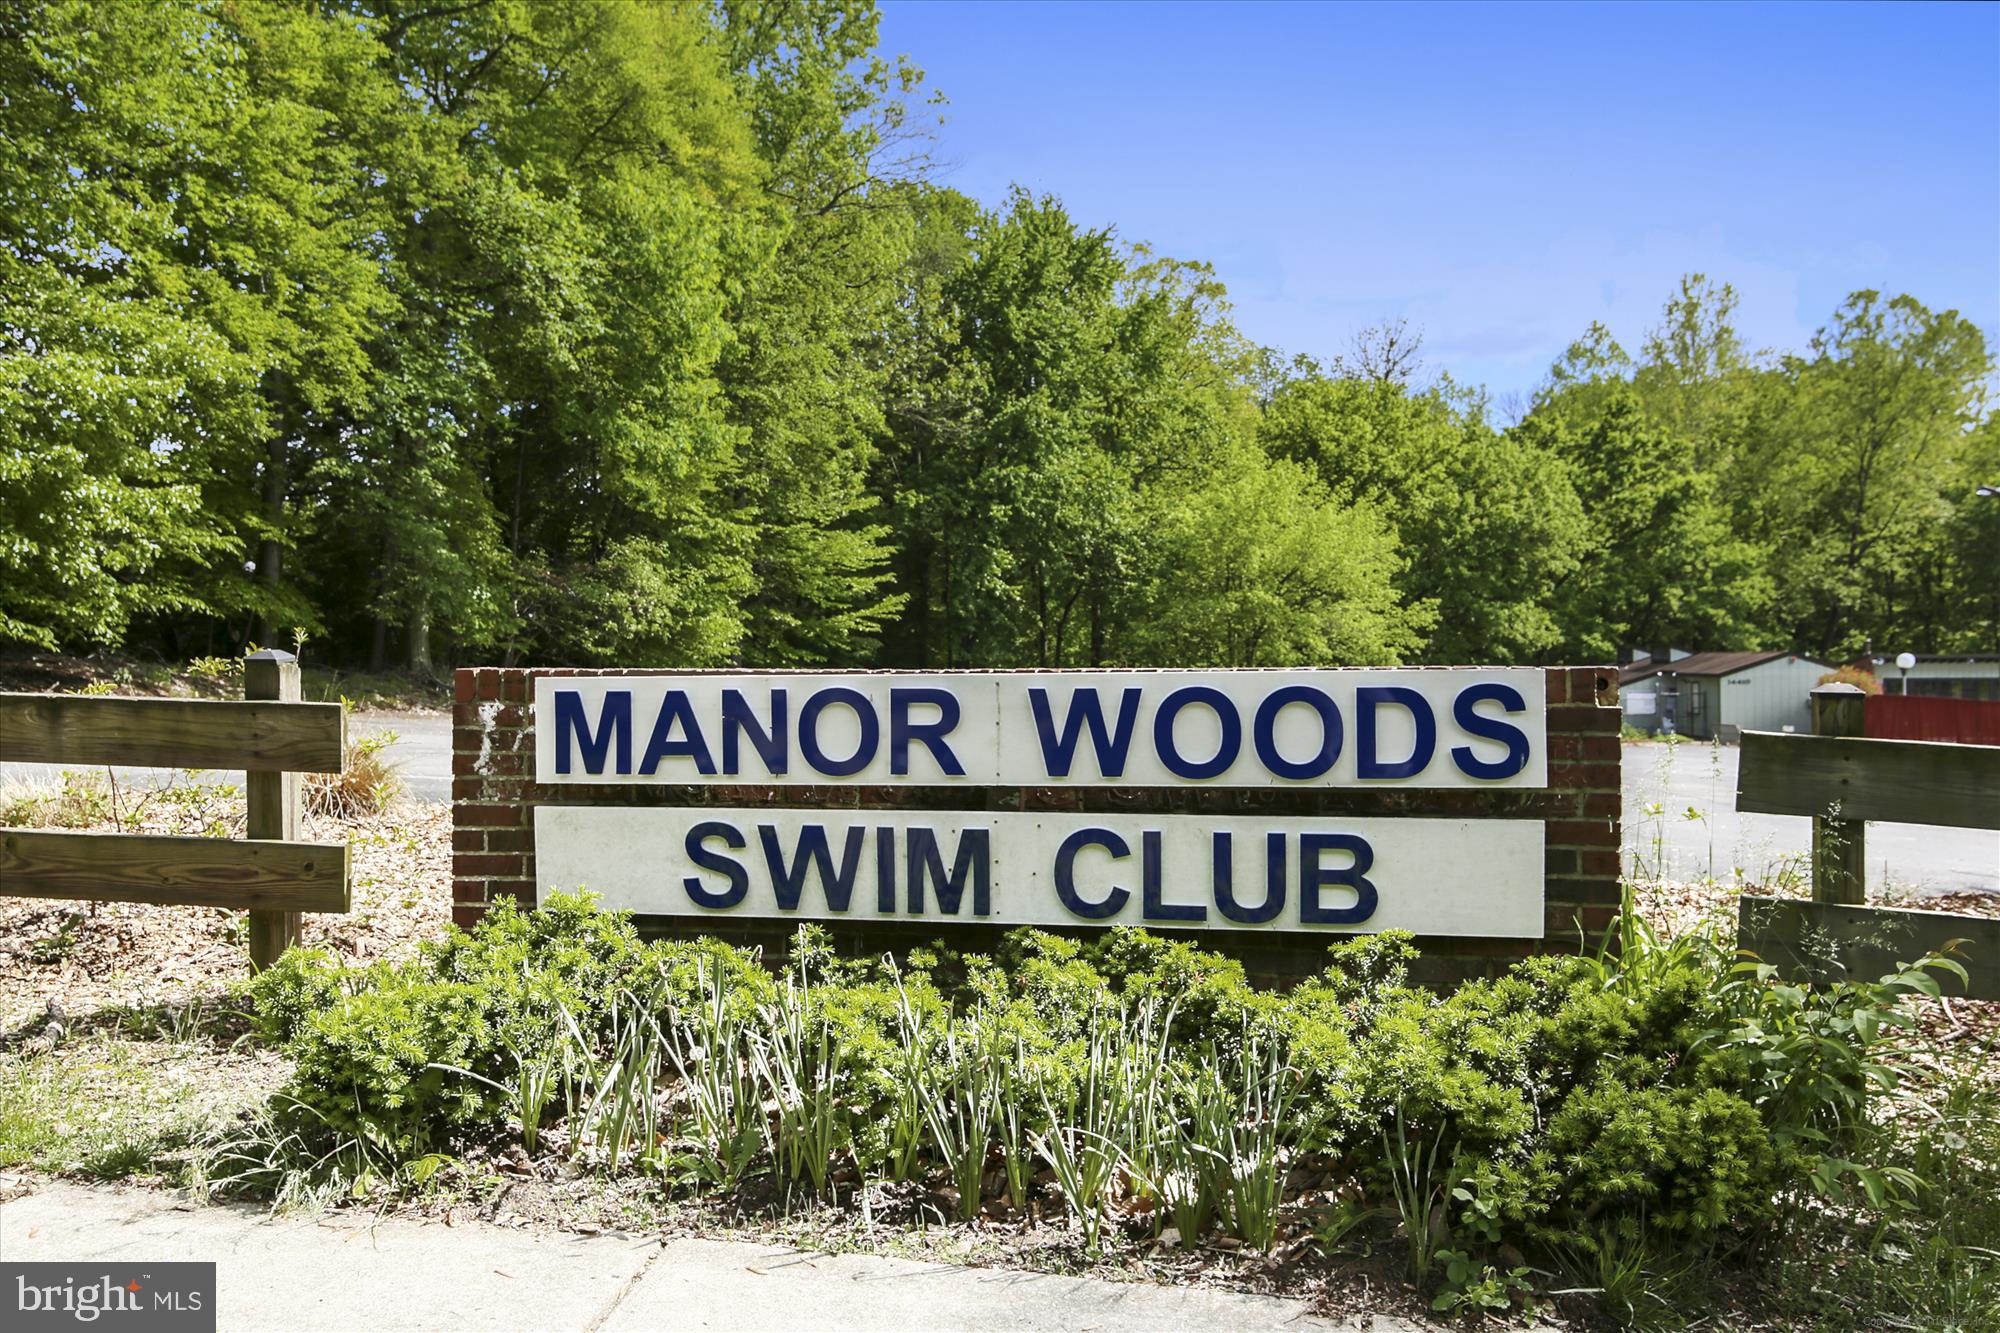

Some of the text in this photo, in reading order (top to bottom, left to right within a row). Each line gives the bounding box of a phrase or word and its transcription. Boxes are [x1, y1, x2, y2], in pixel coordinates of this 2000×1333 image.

[554, 683, 1530, 781] MANOR WOODS
[683, 821, 1378, 925] SWIM CLUB
